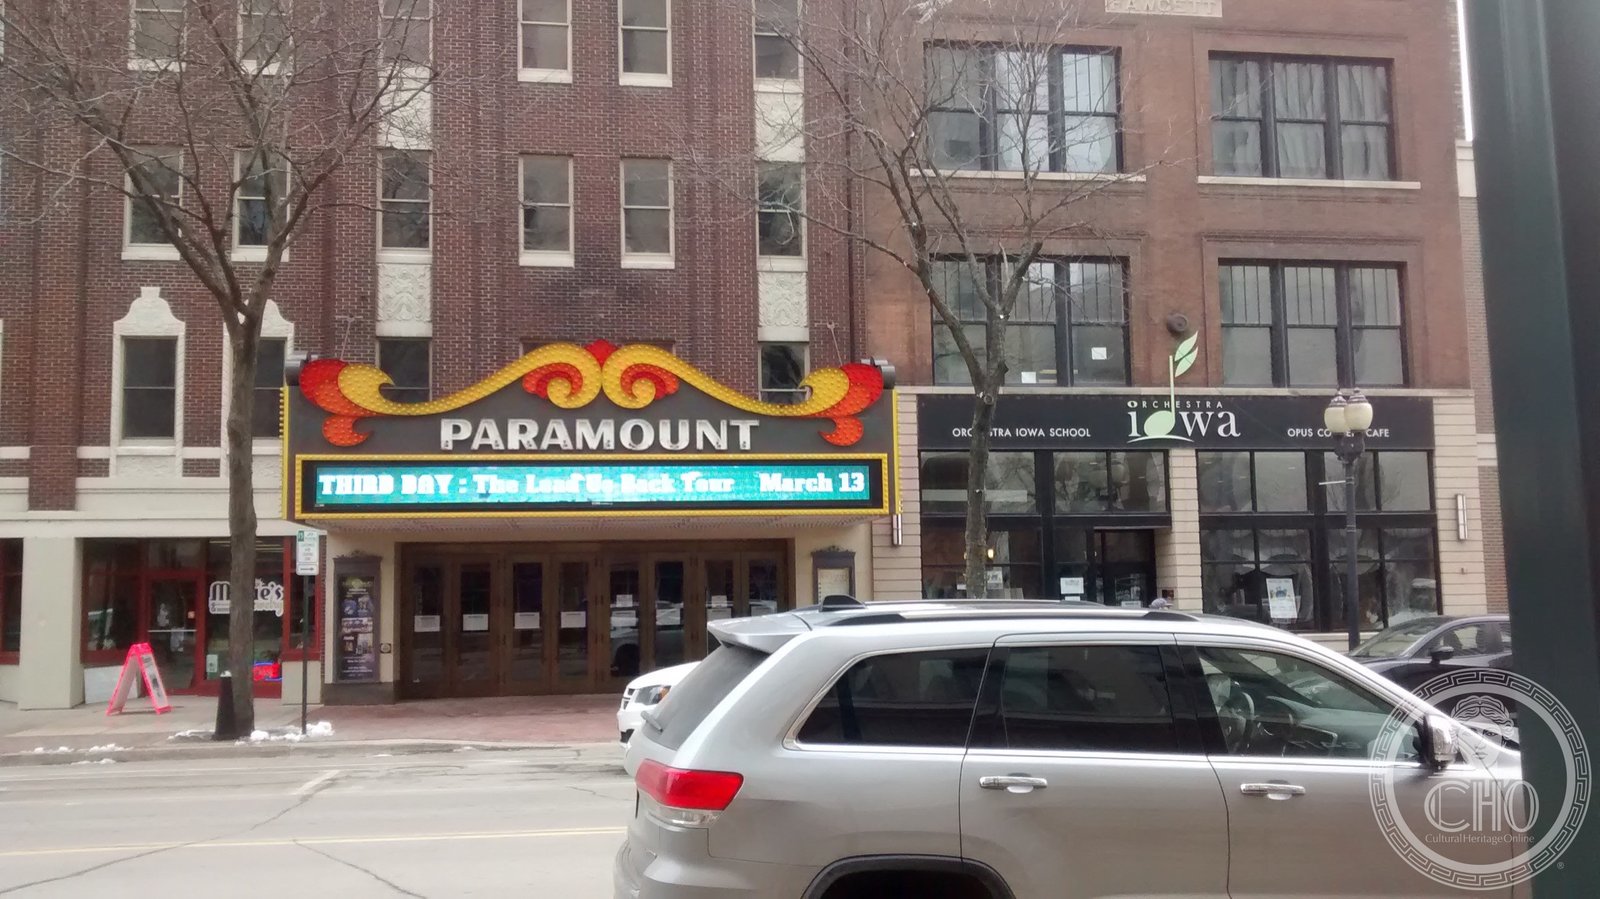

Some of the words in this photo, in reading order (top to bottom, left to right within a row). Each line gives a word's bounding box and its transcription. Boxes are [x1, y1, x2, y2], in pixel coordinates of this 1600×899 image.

[1127, 400, 1223, 409] ORCHESTRA
[440, 418, 761, 451] PARAMOUNT
[1015, 427, 1046, 437] IOWA
[1049, 427, 1091, 437] SCHOOL
[1287, 428, 1314, 438] OPUS
[1365, 428, 1390, 438] CAFE
[318, 474, 394, 495] THIRD
[400, 474, 454, 495] DAY
[472, 474, 519, 494] The
[680, 471, 735, 493] Tour
[759, 472, 834, 493] March
[838, 472, 866, 493] 13
